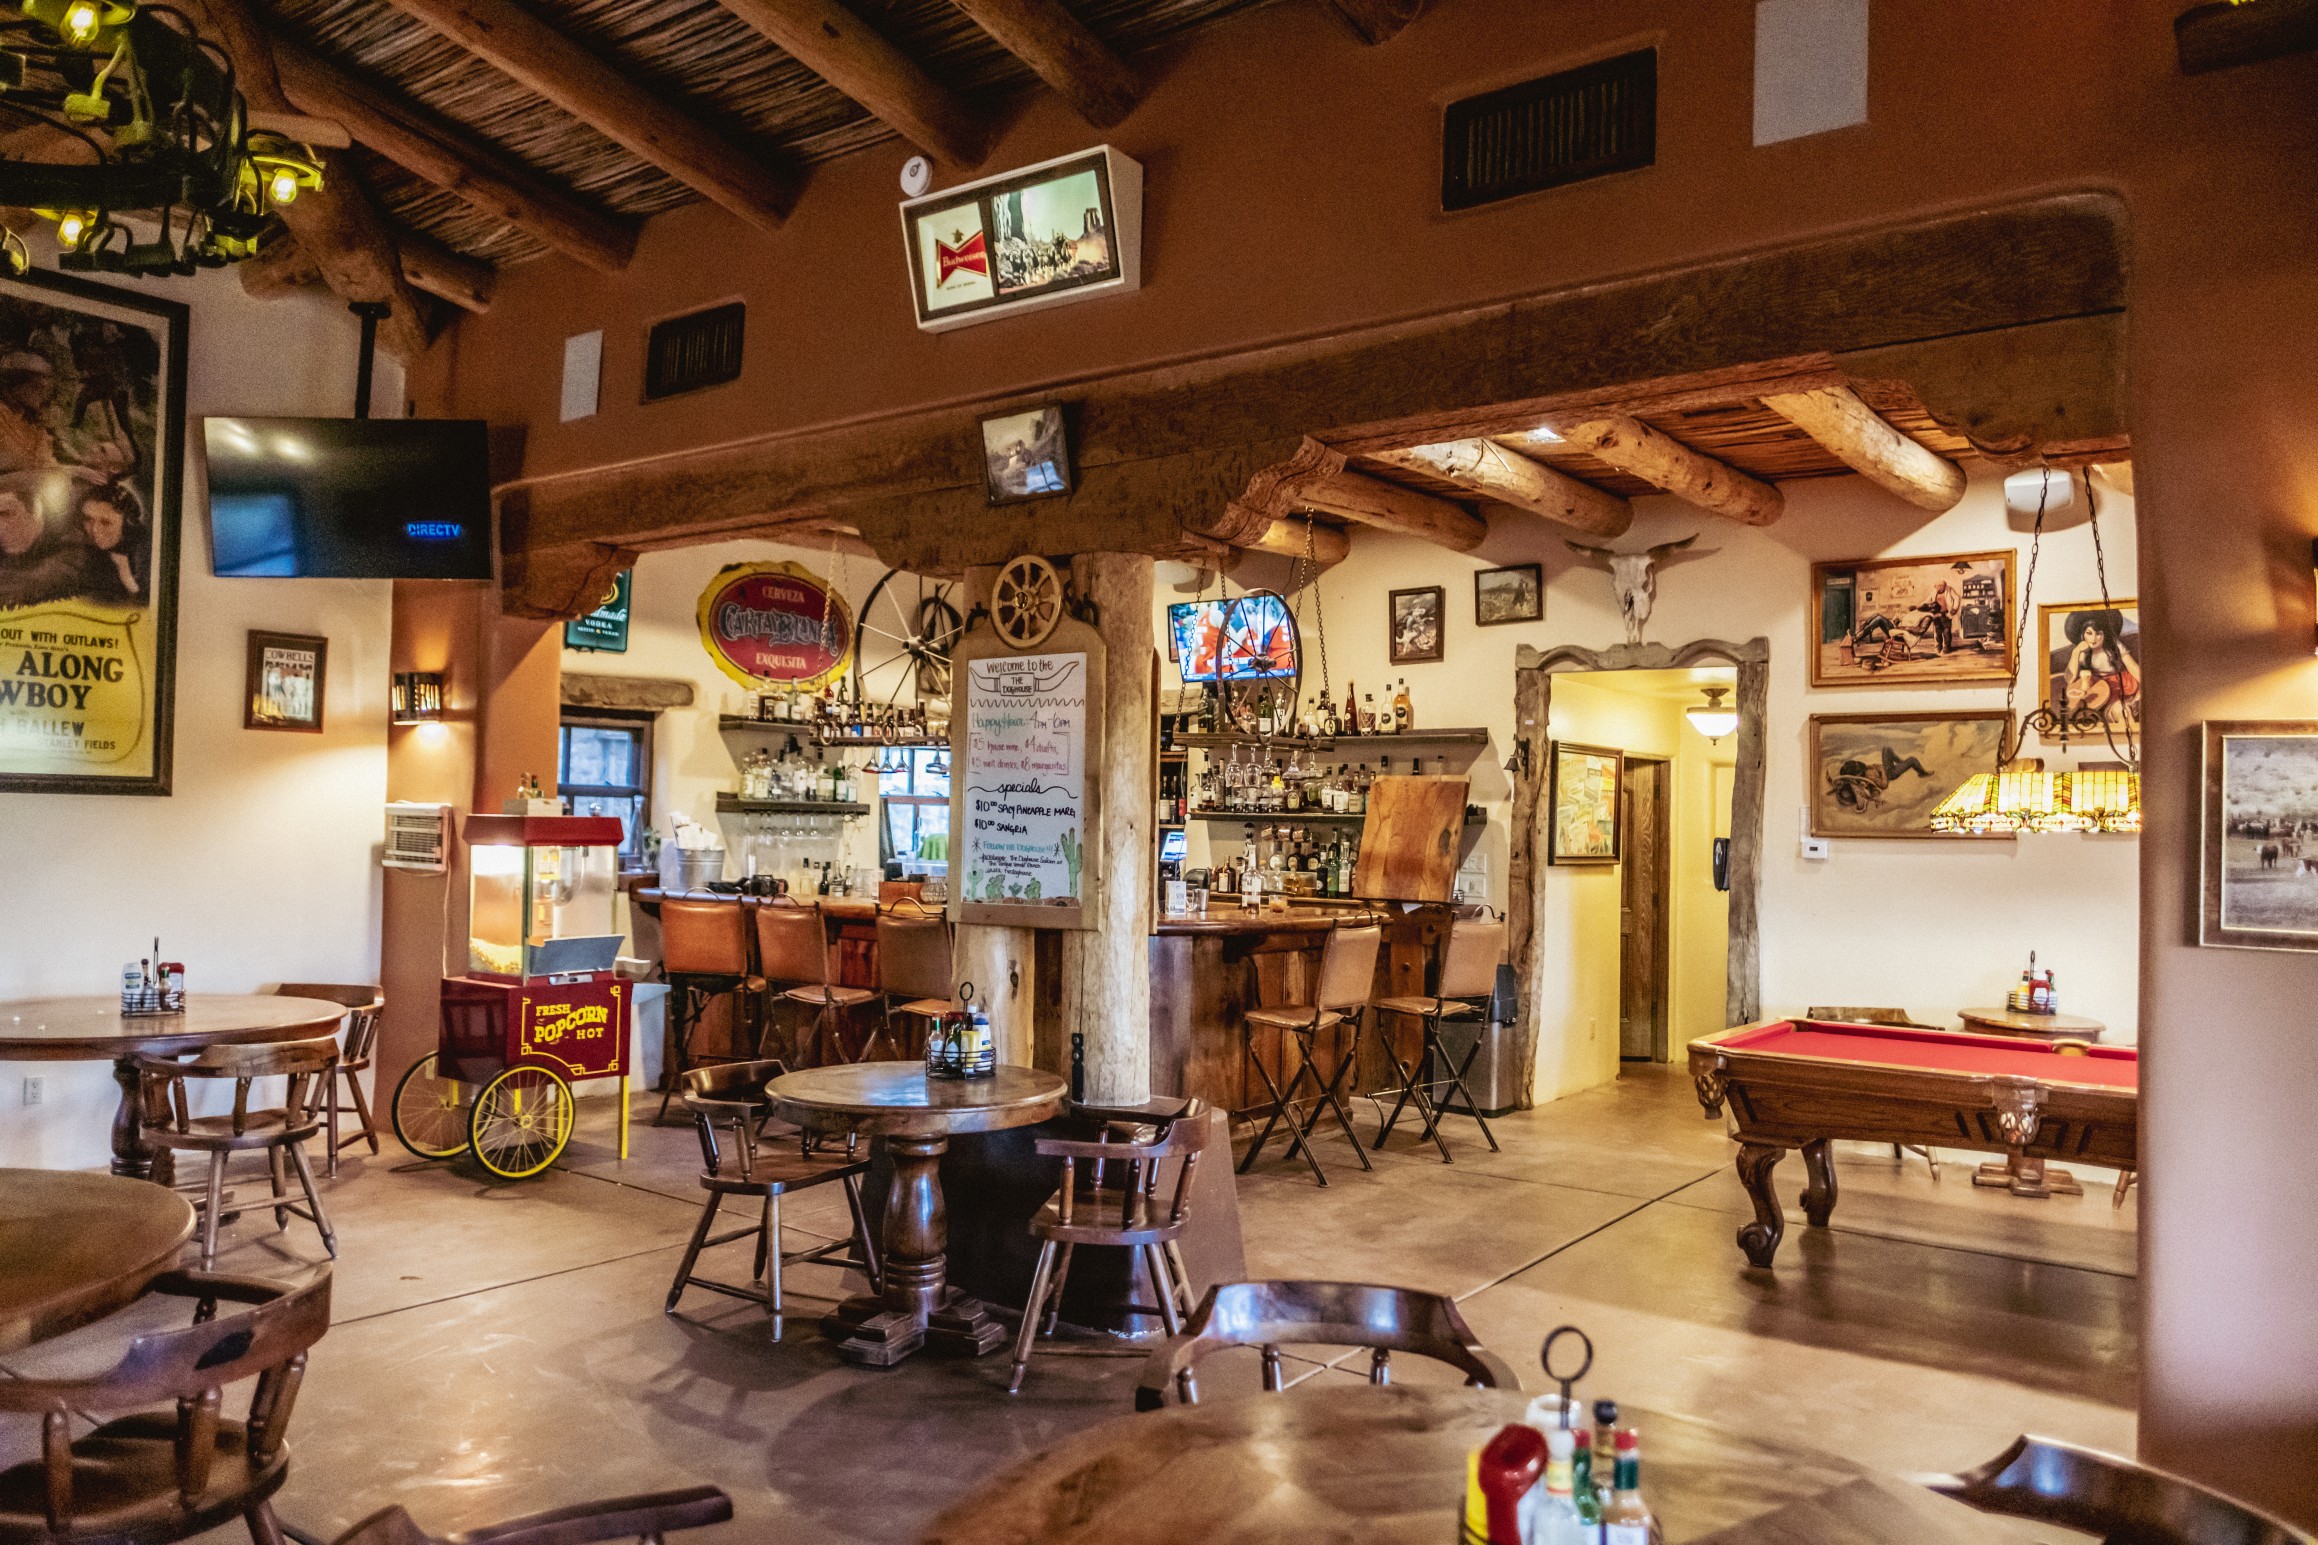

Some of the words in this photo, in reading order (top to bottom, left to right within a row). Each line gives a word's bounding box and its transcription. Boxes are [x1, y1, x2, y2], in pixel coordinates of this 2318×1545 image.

[942, 250, 987, 267] Budweiser
[407, 523, 460, 537] DIRECTV
[762, 585, 805, 603] CERVEZA
[585, 619, 613, 629] VODKA
[31, 630, 57, 643] WITH
[63, 633, 119, 649] OUTLAWS!
[16, 650, 125, 683] ALONG
[755, 653, 807, 670] EXQUISITA
[987, 661, 1025, 674] Welcome
[1027, 659, 1038, 672] to
[1039, 659, 1054, 672] the
[1011, 676, 1023, 685] THE
[1002, 685, 1033, 694] DOGHOUSE
[84, 740, 116, 750] FIELDS
[997, 777, 1042, 801] specials
[997, 803, 1016, 819] SPICY
[1016, 804, 1052, 817] PINEAPPLE
[1053, 806, 1076, 819] MARG
[996, 822, 1028, 836] SANGRIA
[535, 1003, 571, 1017] FRESH
[534, 1005, 609, 1043] POPCORN
[576, 1027, 604, 1040] HOT
